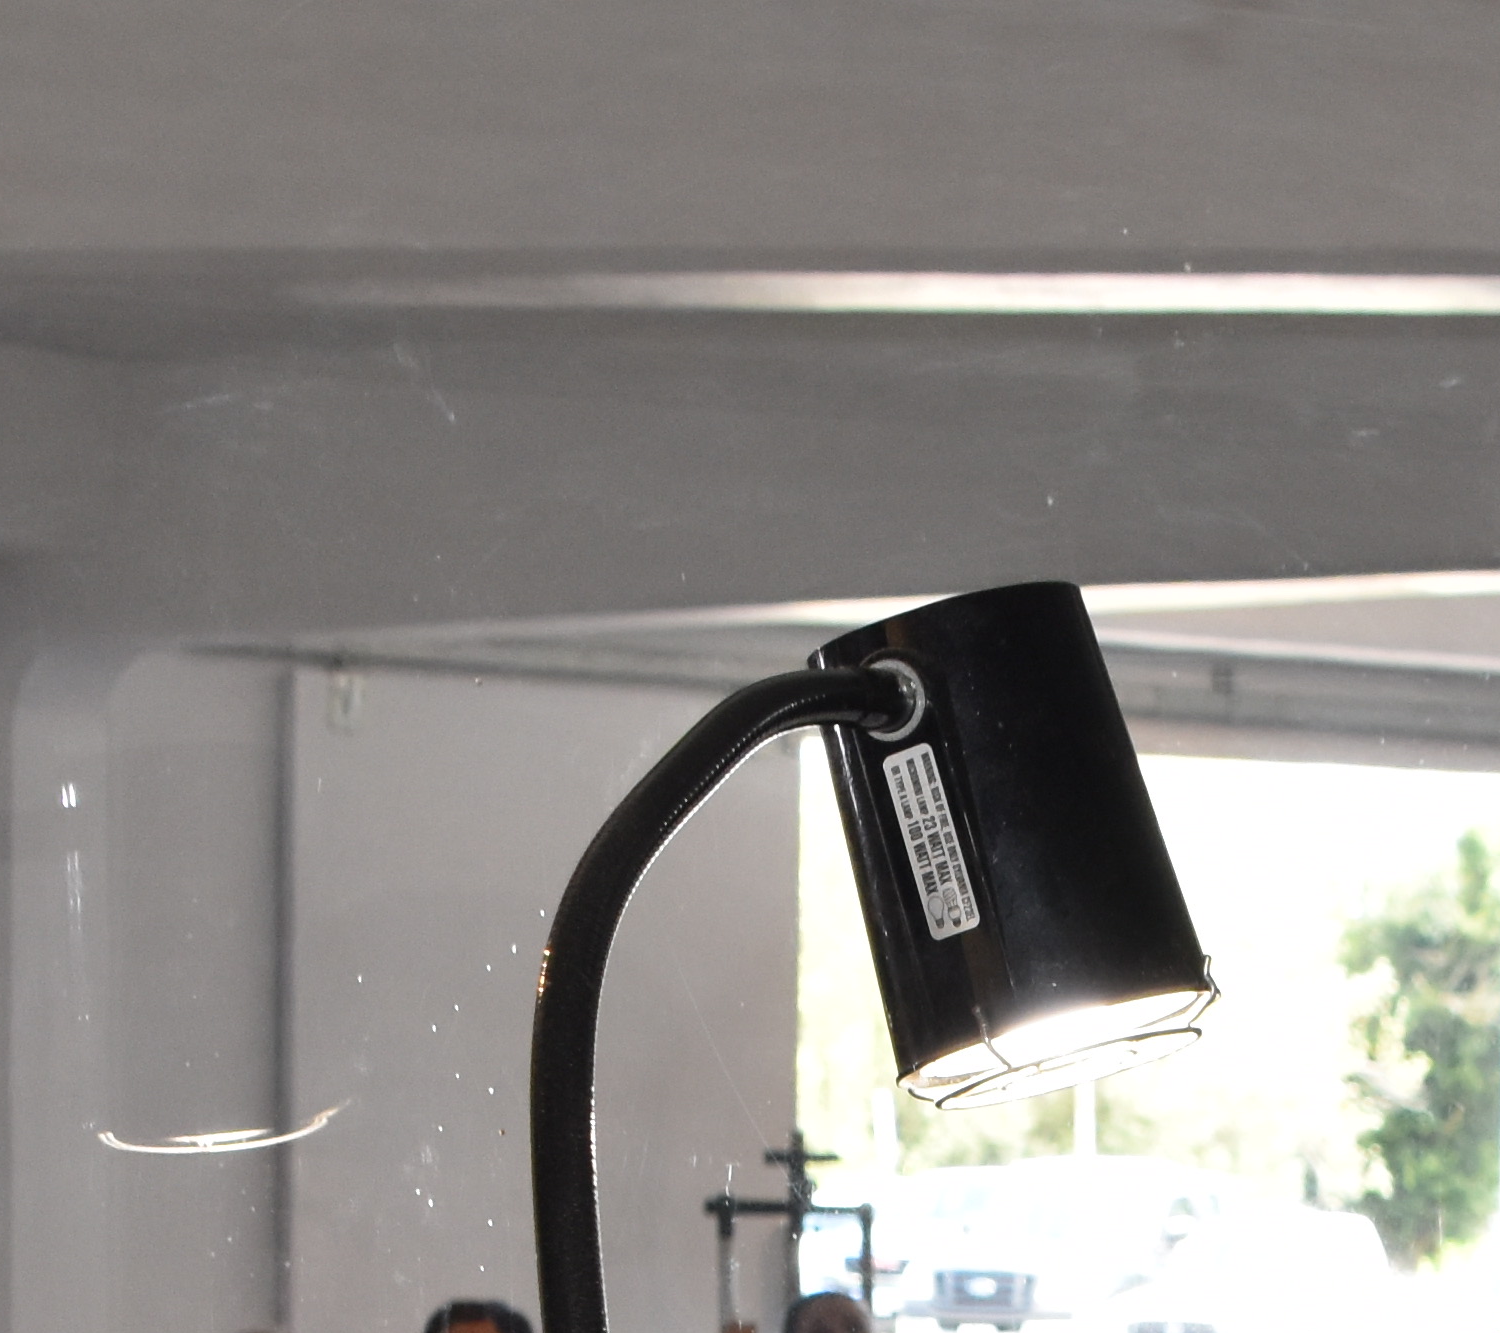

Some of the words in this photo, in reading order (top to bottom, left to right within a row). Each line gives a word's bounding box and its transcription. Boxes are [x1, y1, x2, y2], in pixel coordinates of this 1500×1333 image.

[907, 820, 923, 841] 100
[922, 815, 937, 831] 23
[913, 841, 932, 869] WATT
[927, 831, 946, 859] WATT
[921, 871, 938, 897] MAX
[935, 860, 952, 886] MAX
